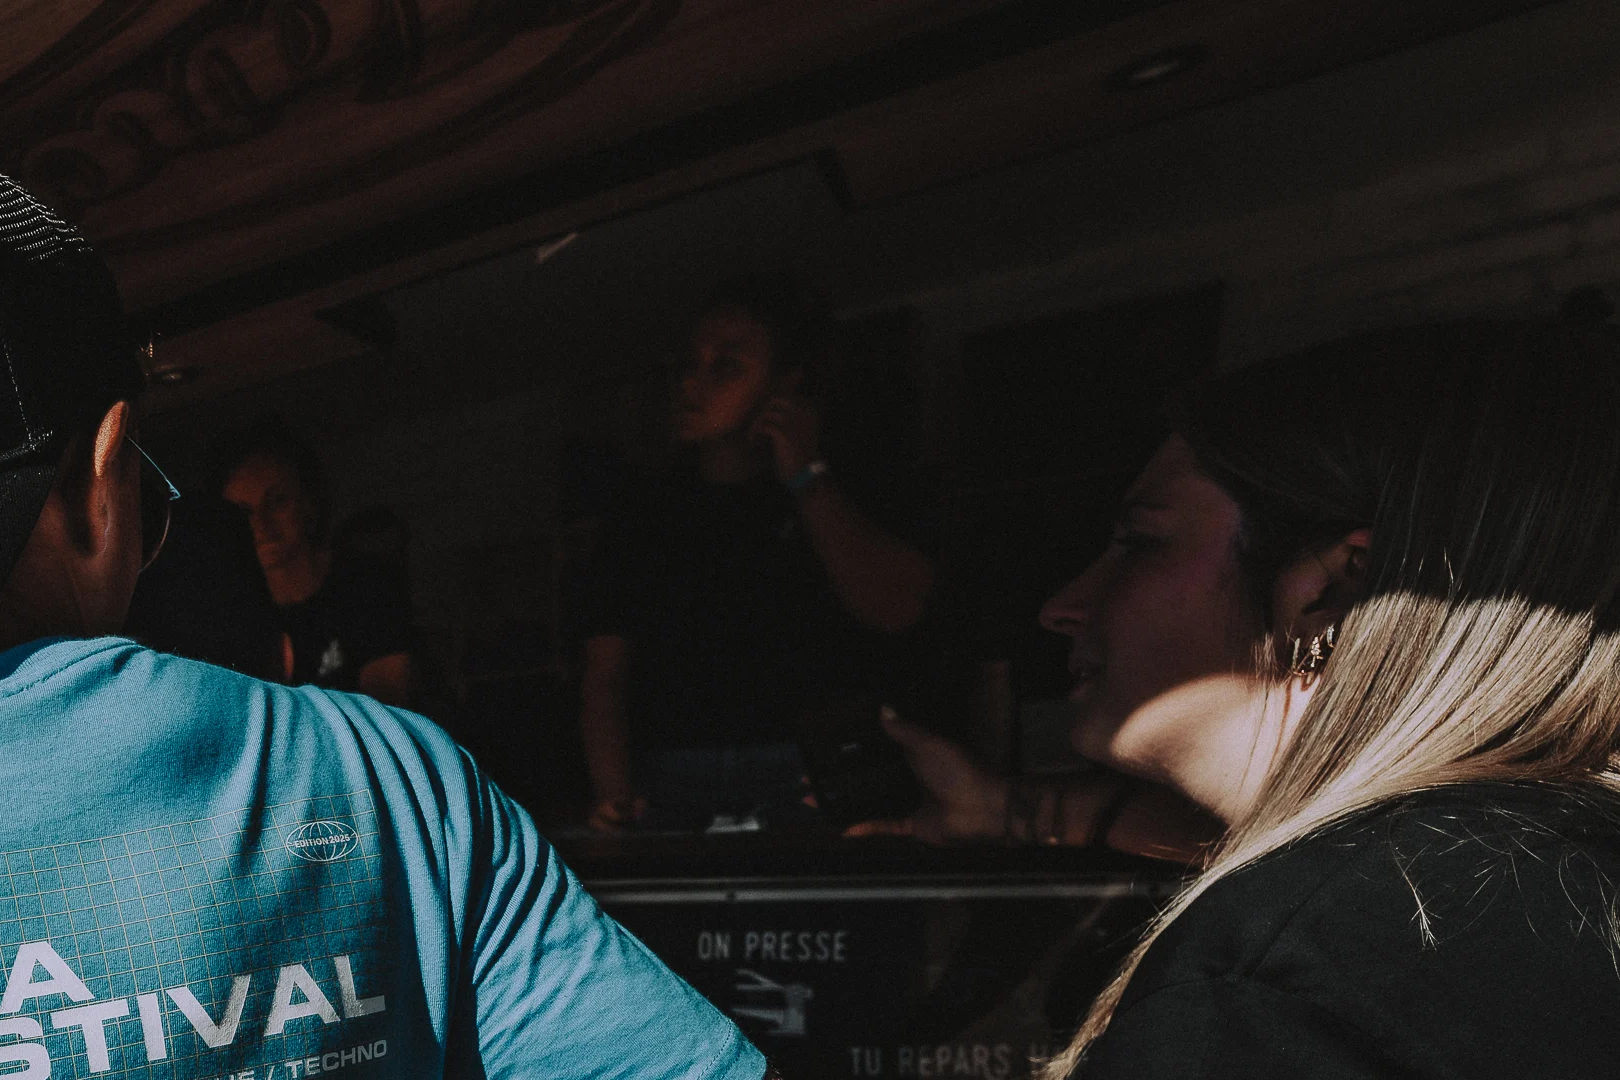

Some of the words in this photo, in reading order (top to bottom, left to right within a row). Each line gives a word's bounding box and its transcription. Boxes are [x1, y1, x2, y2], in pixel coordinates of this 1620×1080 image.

[294, 836, 329, 848] EDITION
[329, 834, 351, 845] 2025
[697, 931, 731, 962] ON
[744, 931, 848, 963] PRESSE
[284, 1039, 388, 1079] TECHNO
[849, 1046, 882, 1077] TU
